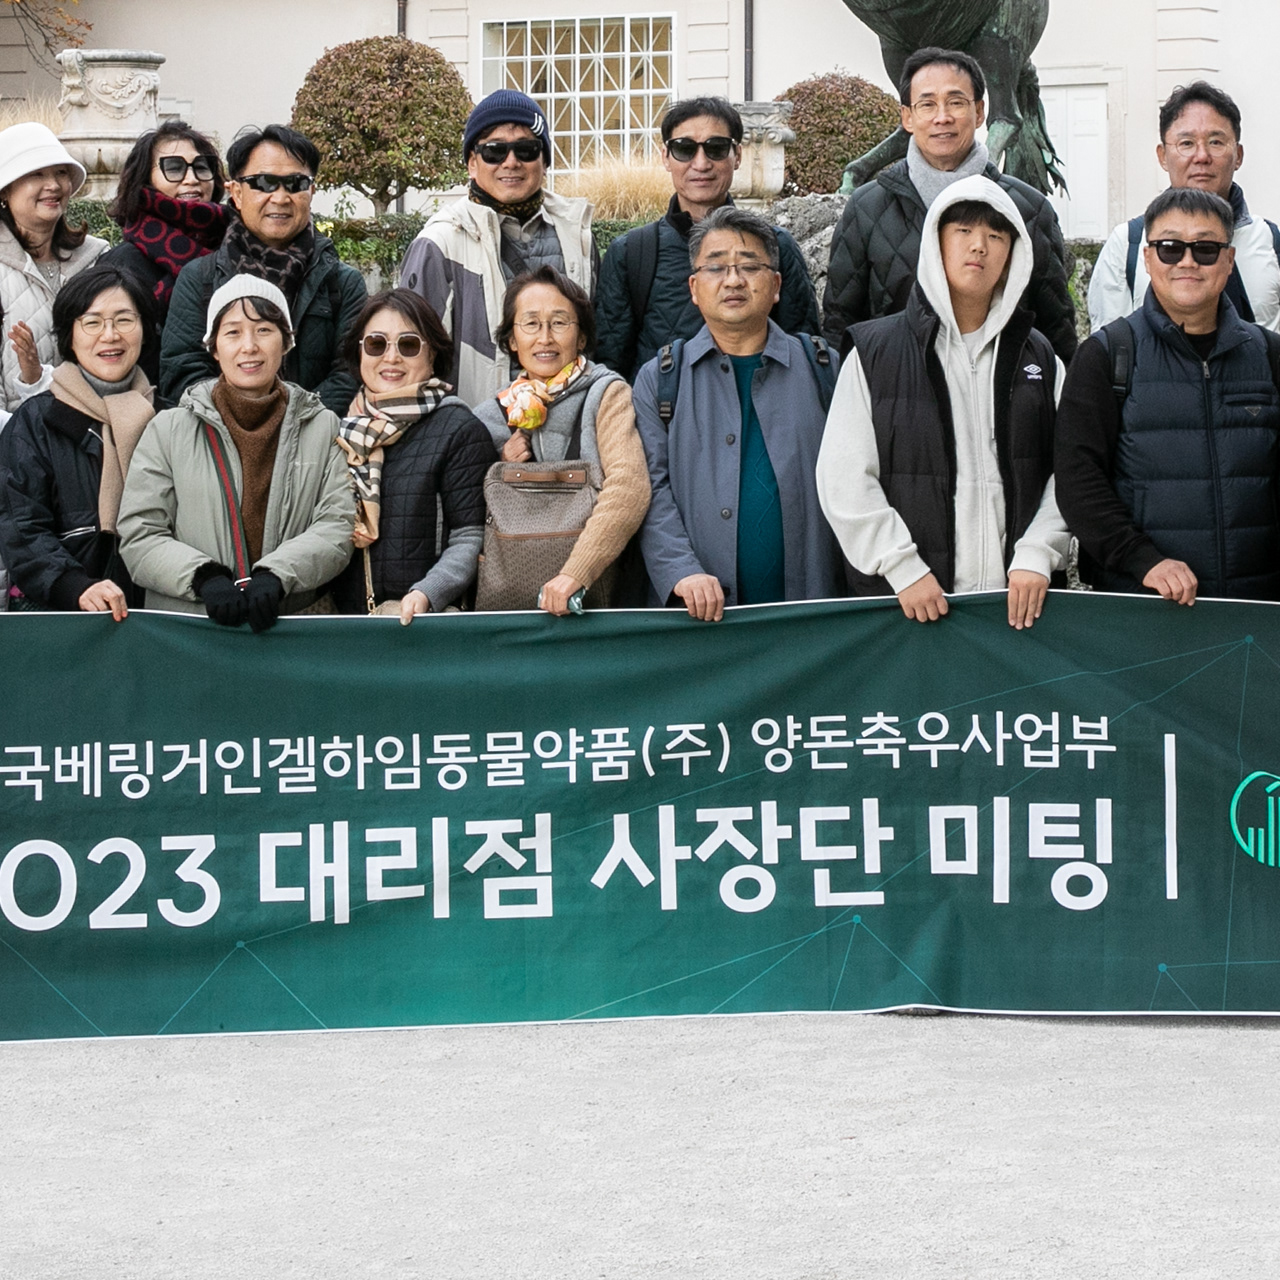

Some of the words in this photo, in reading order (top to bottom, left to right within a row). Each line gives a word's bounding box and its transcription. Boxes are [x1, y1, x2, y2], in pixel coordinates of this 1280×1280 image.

[751, 710, 1117, 773] 양돈축우사업부
[259, 812, 553, 924] 대리점
[590, 797, 895, 913] 사장단
[928, 796, 1113, 911] 미팅
